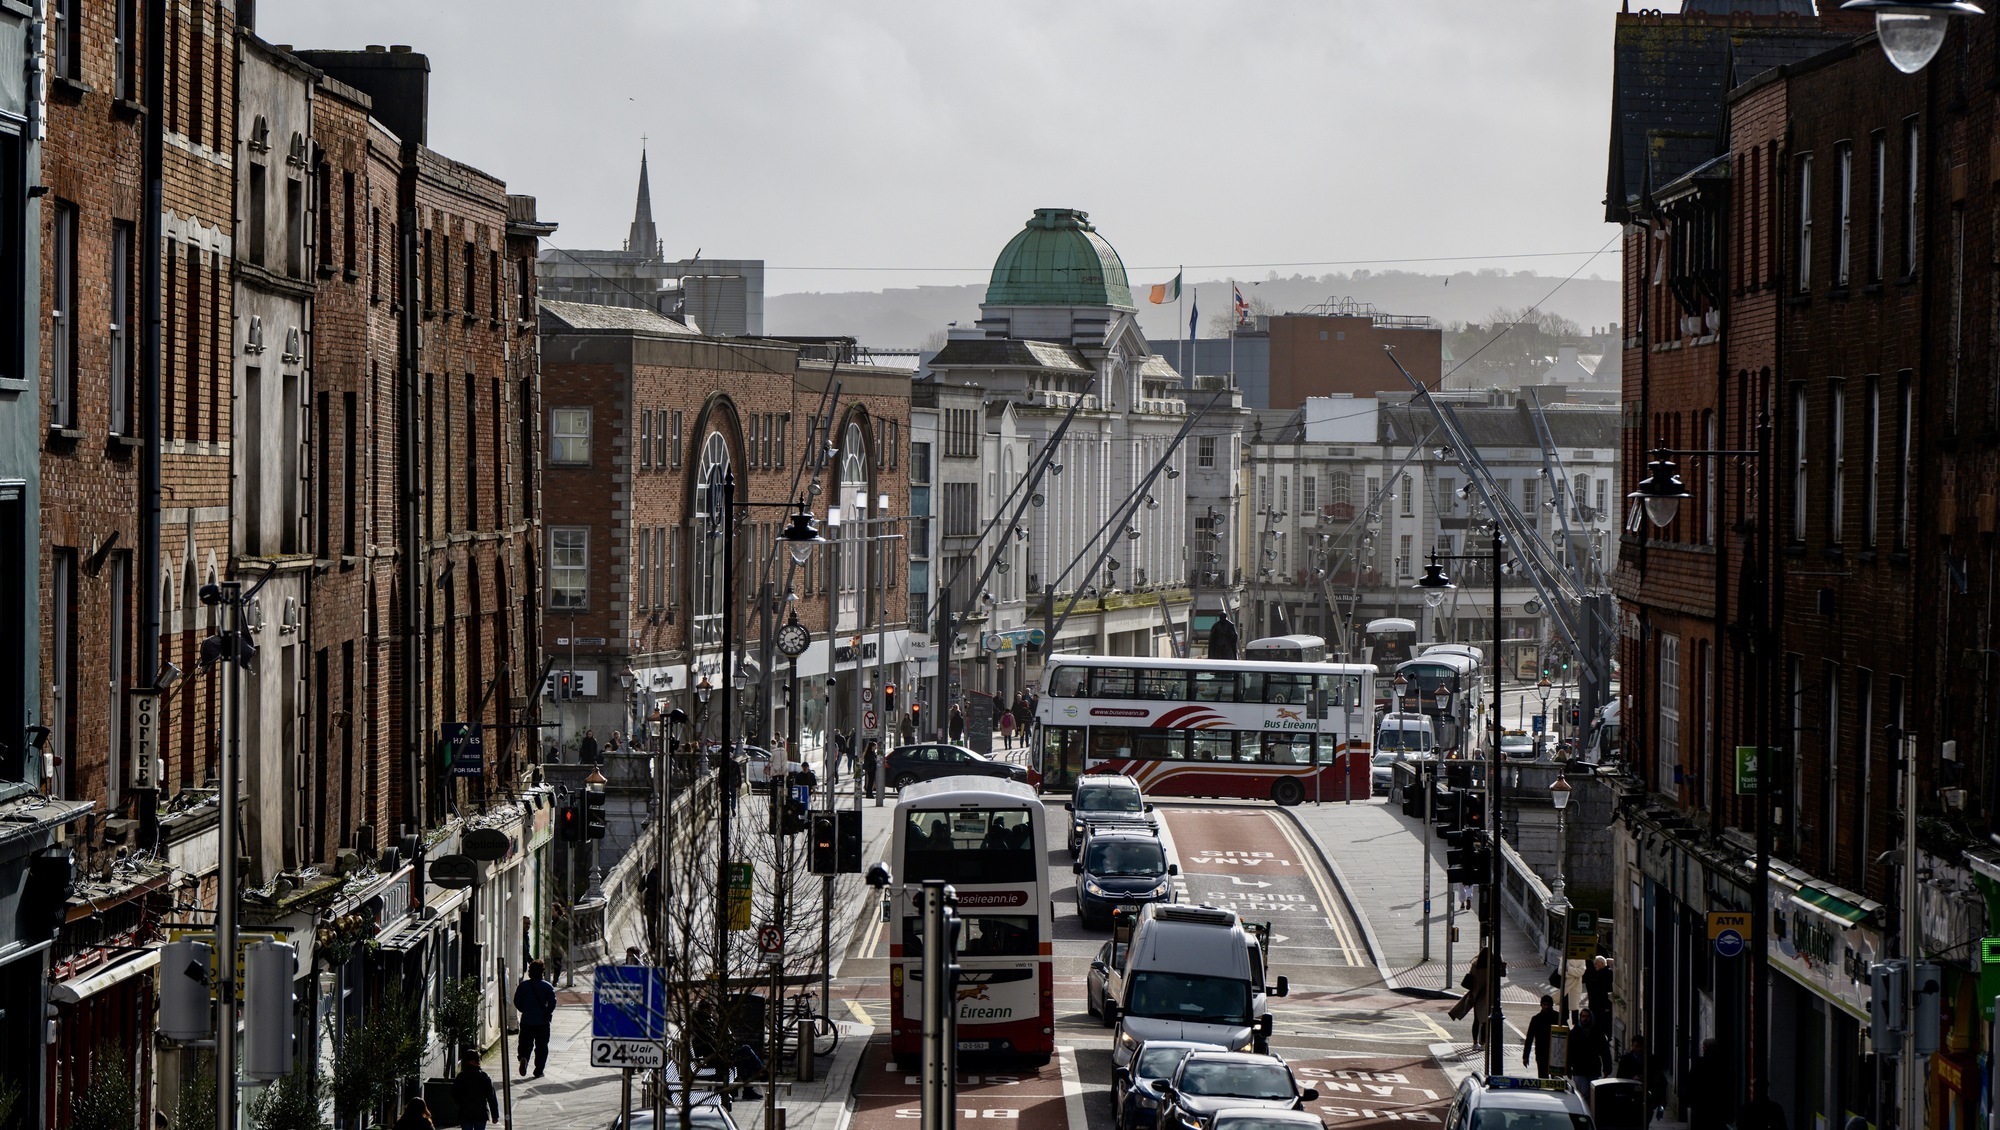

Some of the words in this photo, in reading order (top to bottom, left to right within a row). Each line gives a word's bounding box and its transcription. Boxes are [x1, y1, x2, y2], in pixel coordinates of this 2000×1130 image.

[1094, 708, 1145, 716] www.buseireann.ie
[1263, 719, 1281, 729] Bus
[1282, 719, 1317, 730] Éireann
[138, 698, 152, 783] COFFEE
[452, 737, 481, 745] HAES
[1716, 916, 1744, 926] ATM
[959, 1004, 1013, 1019] Éireann
[597, 1043, 628, 1064] 24
[630, 1044, 654, 1053] Uair
[630, 1056, 659, 1065] HOUR
[1298, 1067, 1411, 1084] BUS
[1517, 1079, 1541, 1087] TAXI
[1319, 1106, 1443, 1123] BUS
